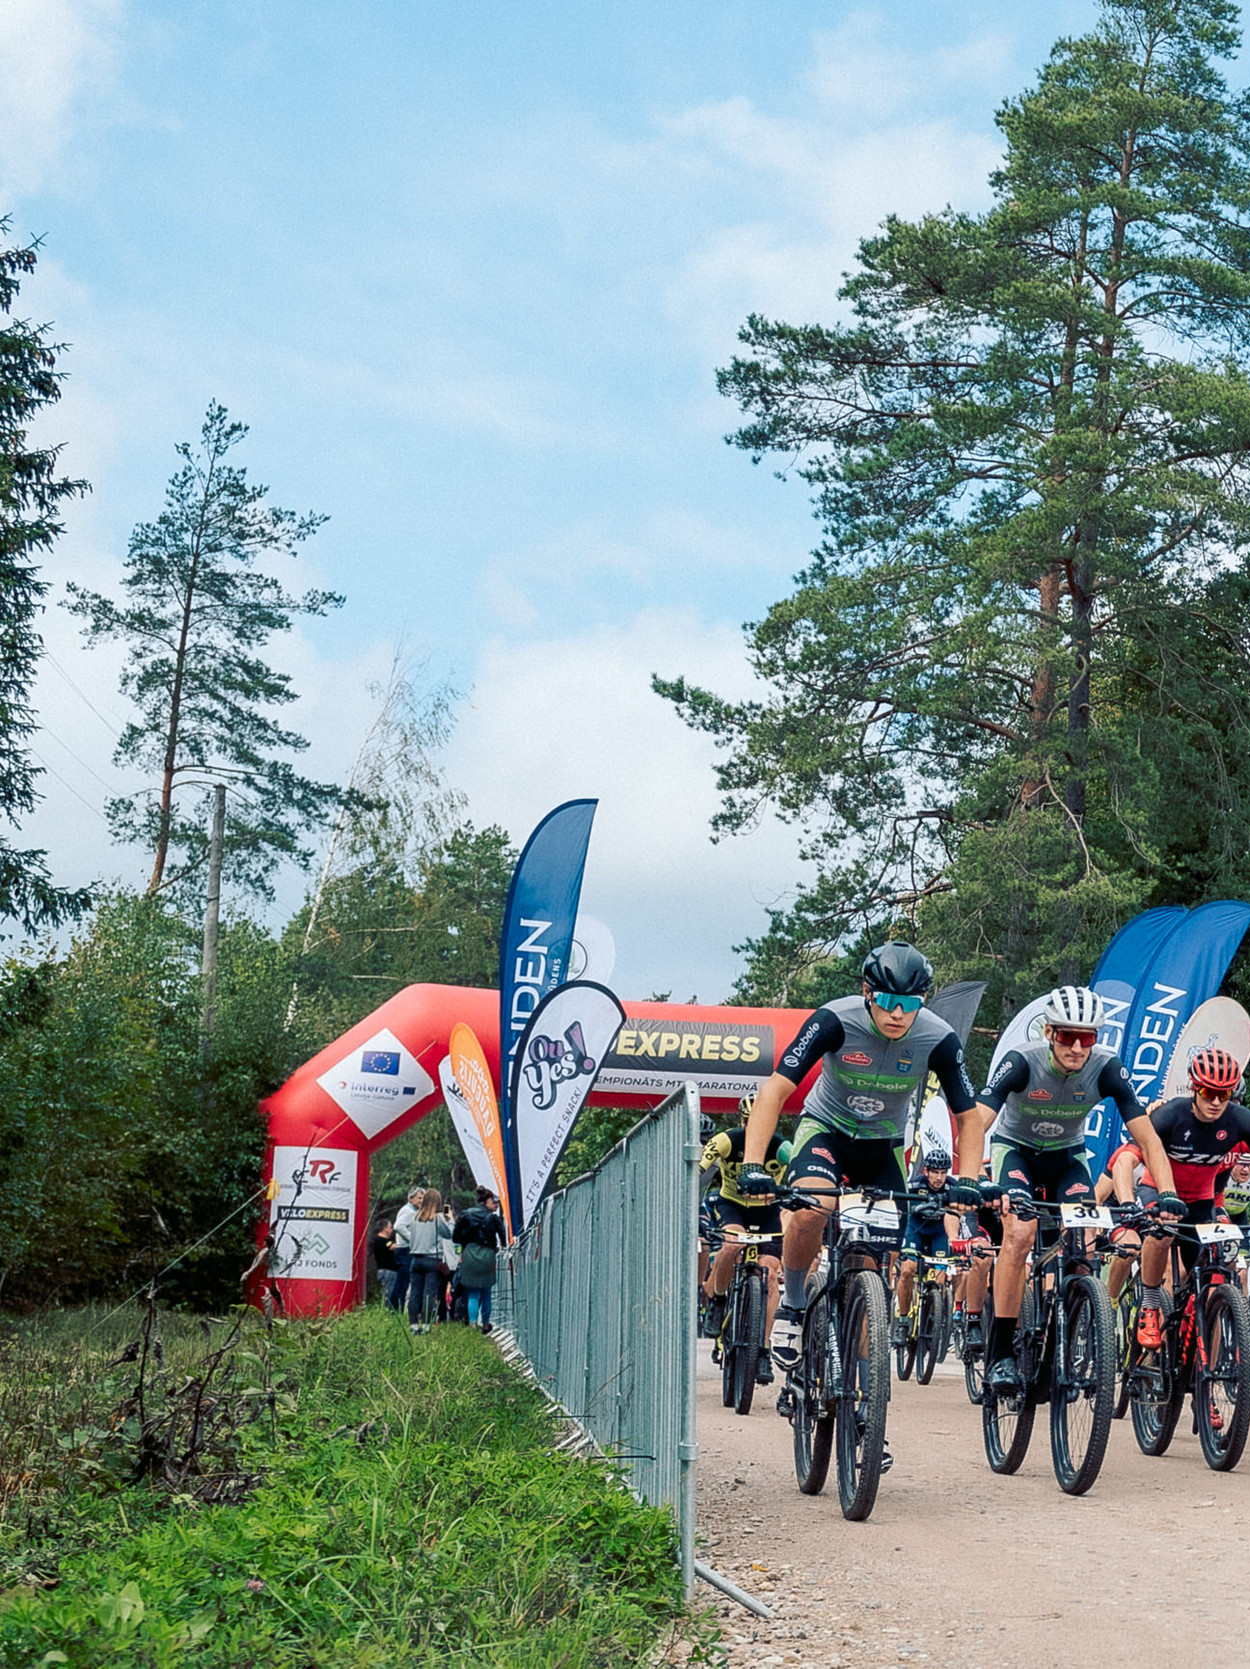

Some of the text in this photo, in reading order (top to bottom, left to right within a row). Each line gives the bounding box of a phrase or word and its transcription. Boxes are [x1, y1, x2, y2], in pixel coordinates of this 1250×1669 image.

[611, 1029, 760, 1062] EXPRESS
[792, 1022, 820, 1057] Dobele
[595, 1075, 663, 1088] EMPIONĀTS
[857, 1078, 908, 1090] Dobele
[543, 1126, 565, 1169] PERFECT
[1073, 1207, 1100, 1219] 30
[1213, 1225, 1226, 1234] 4
[305, 1260, 338, 1269] FONDS
